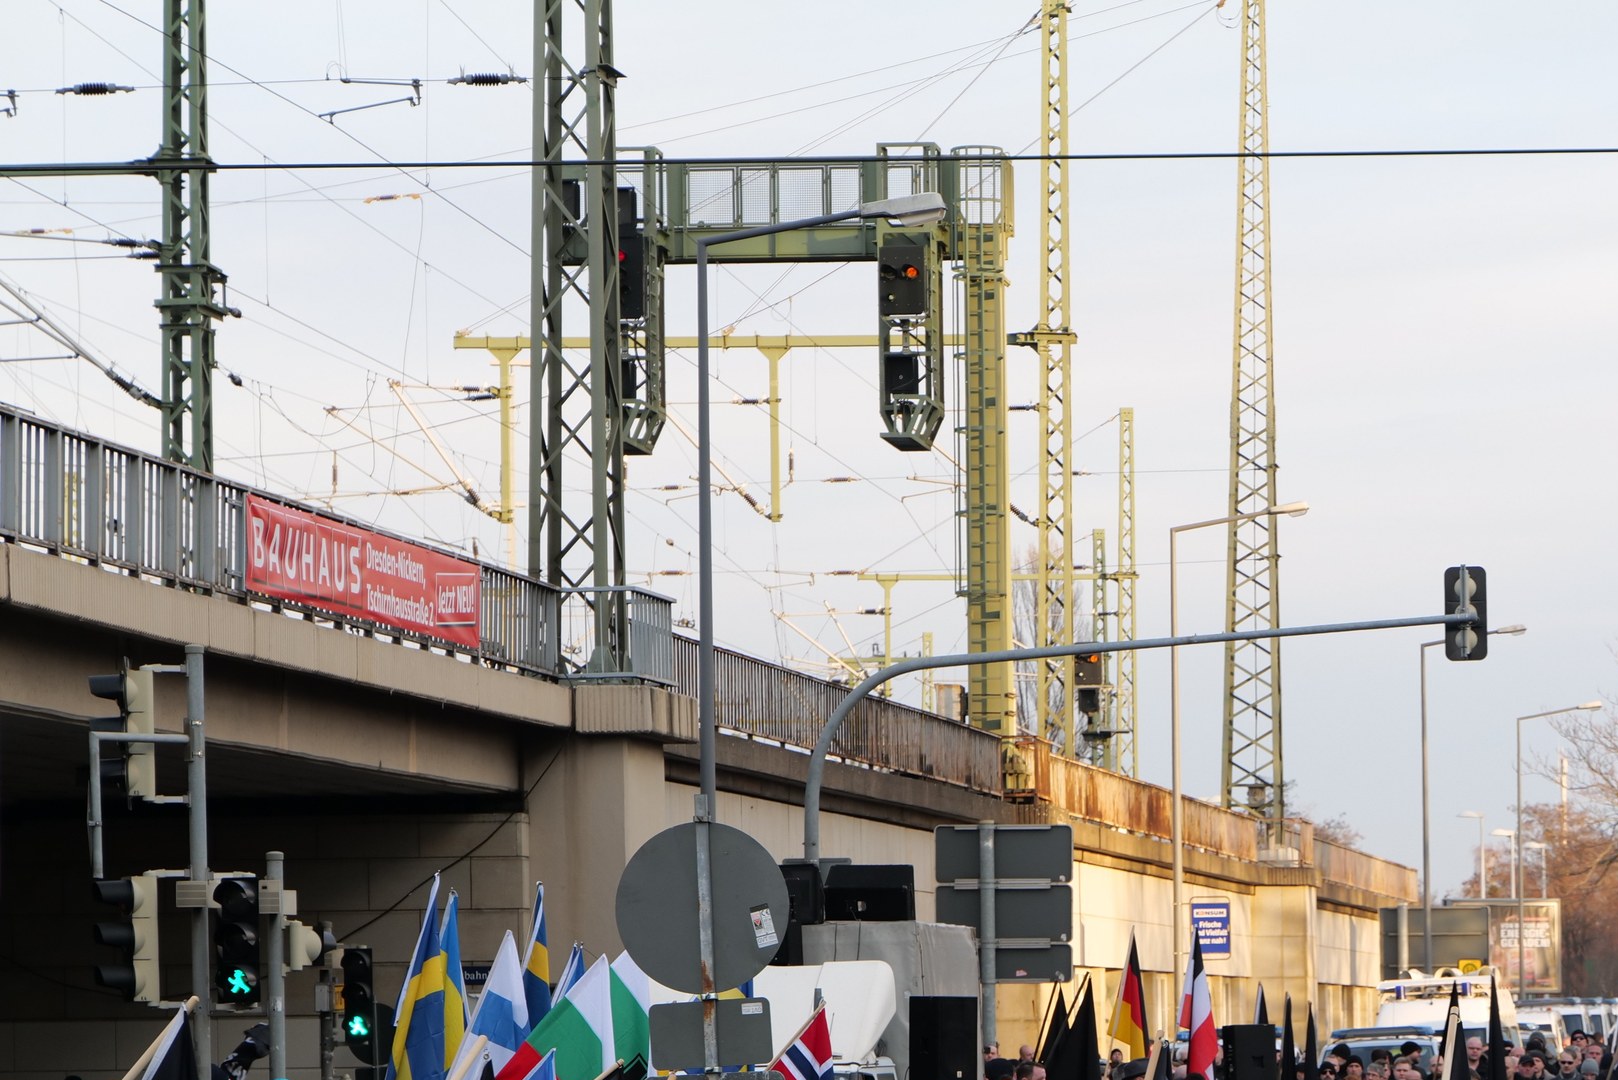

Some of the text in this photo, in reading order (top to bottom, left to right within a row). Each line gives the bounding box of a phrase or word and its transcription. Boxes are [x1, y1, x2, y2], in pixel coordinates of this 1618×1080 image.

[252, 517, 361, 594] BAUHAUS
[366, 543, 426, 590] Dresden-Nickern,
[366, 583, 434, 627] Tschirnhausstraße 2
[437, 585, 475, 614] Jetzt NEU!
[1198, 920, 1222, 929] Frische
[464, 970, 491, 980] bahn
